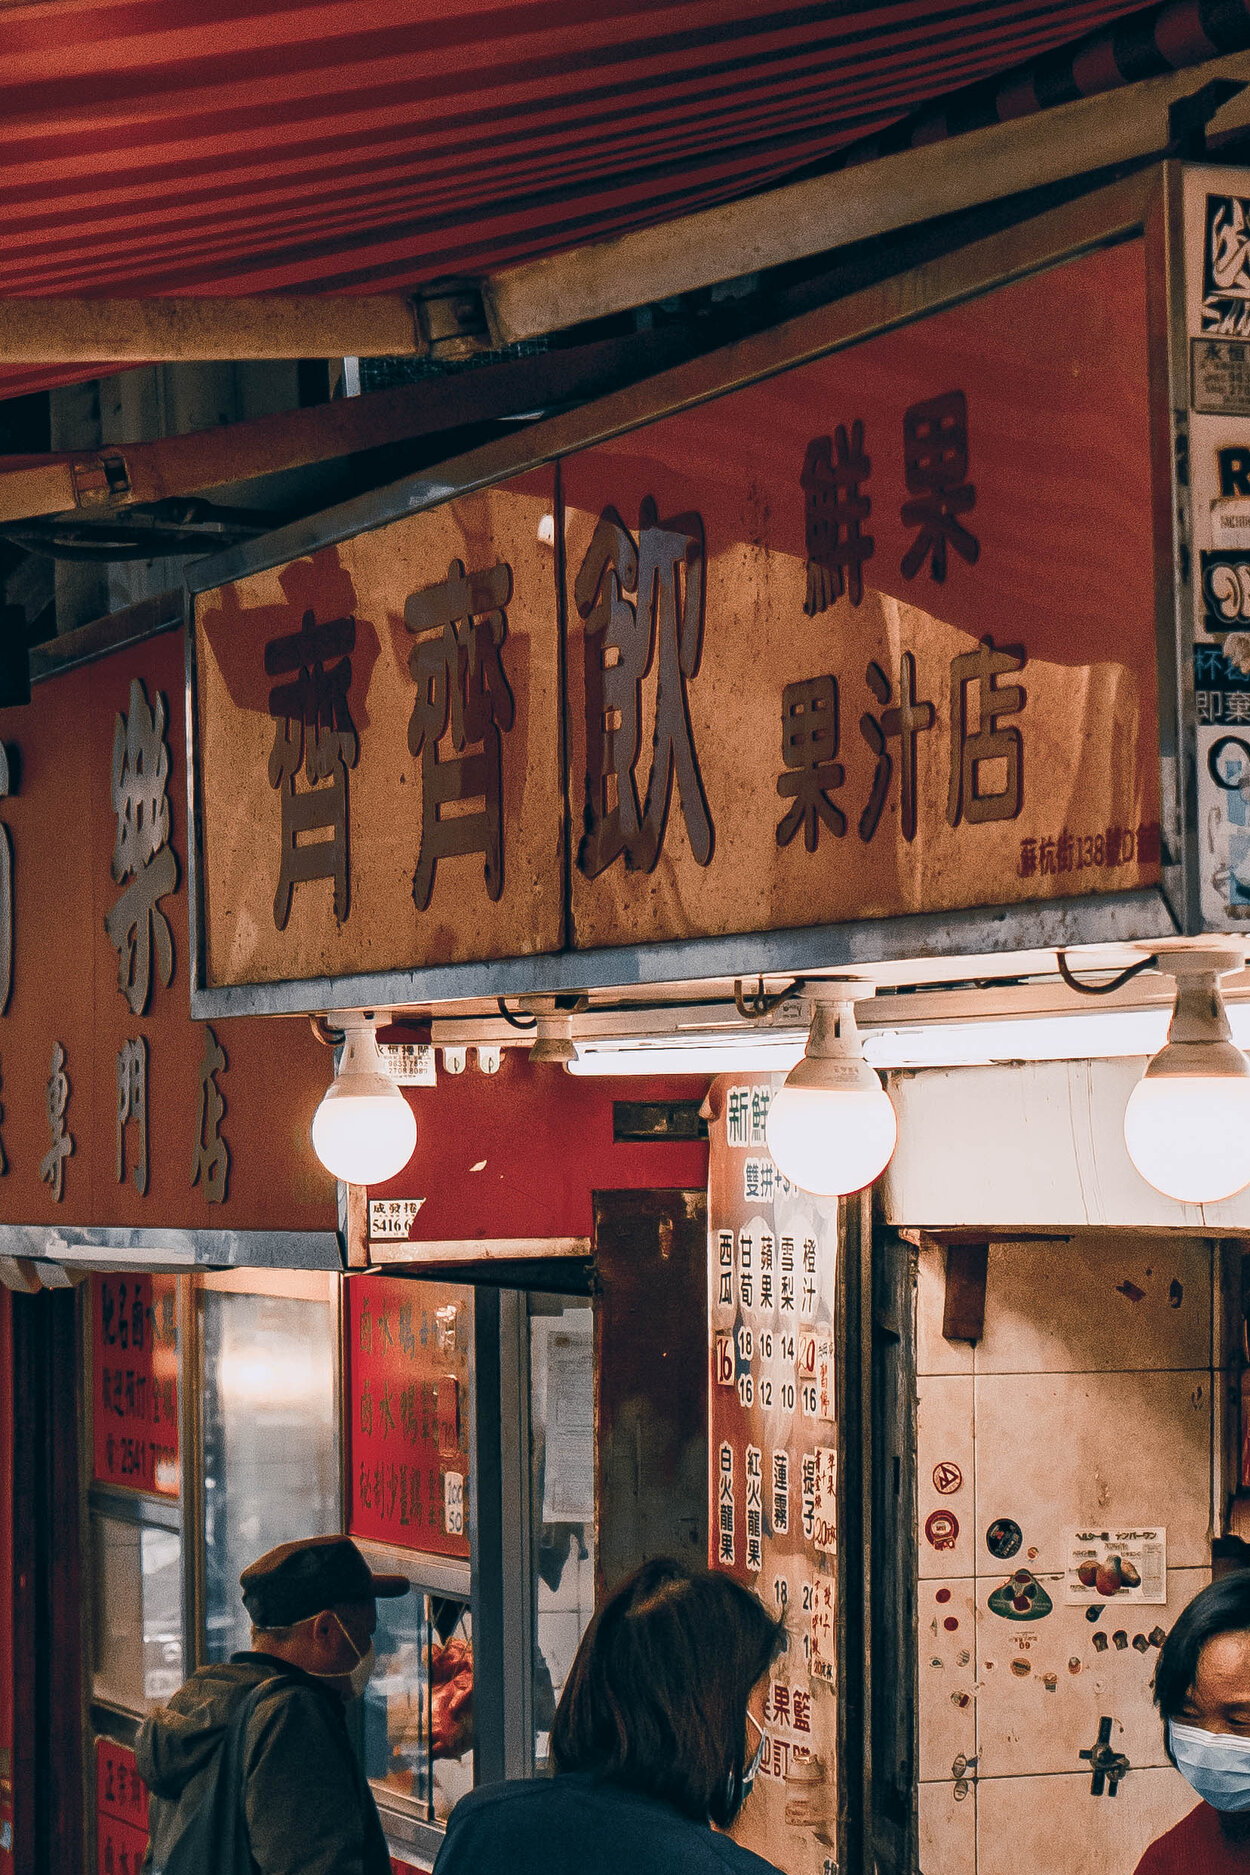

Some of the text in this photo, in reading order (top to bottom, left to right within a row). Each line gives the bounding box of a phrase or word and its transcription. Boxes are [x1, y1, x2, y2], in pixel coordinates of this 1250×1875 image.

[803, 391, 979, 616] 鮮果
[776, 635, 1028, 853] 果汁店
[373, 1202, 419, 1215] 成發捲
[373, 1218, 402, 1233] 5416
[719, 1234, 733, 1306] 西瓜
[760, 1236, 774, 1310] 蘋果
[781, 1237, 795, 1312] 雪梨
[801, 1237, 817, 1313] 橙汁
[740, 1331, 752, 1356] 18
[760, 1333, 773, 1359] 16
[781, 1336, 795, 1361] 14
[800, 1337, 816, 1372] 20
[717, 1338, 732, 1383] 16
[740, 1378, 752, 1404] 16
[760, 1381, 773, 1406] 12
[781, 1384, 794, 1409] 10
[803, 1387, 817, 1413] 16
[720, 1444, 734, 1562] 白火龍果
[746, 1451, 761, 1569] 紅火龍果
[774, 1580, 788, 1605] 18
